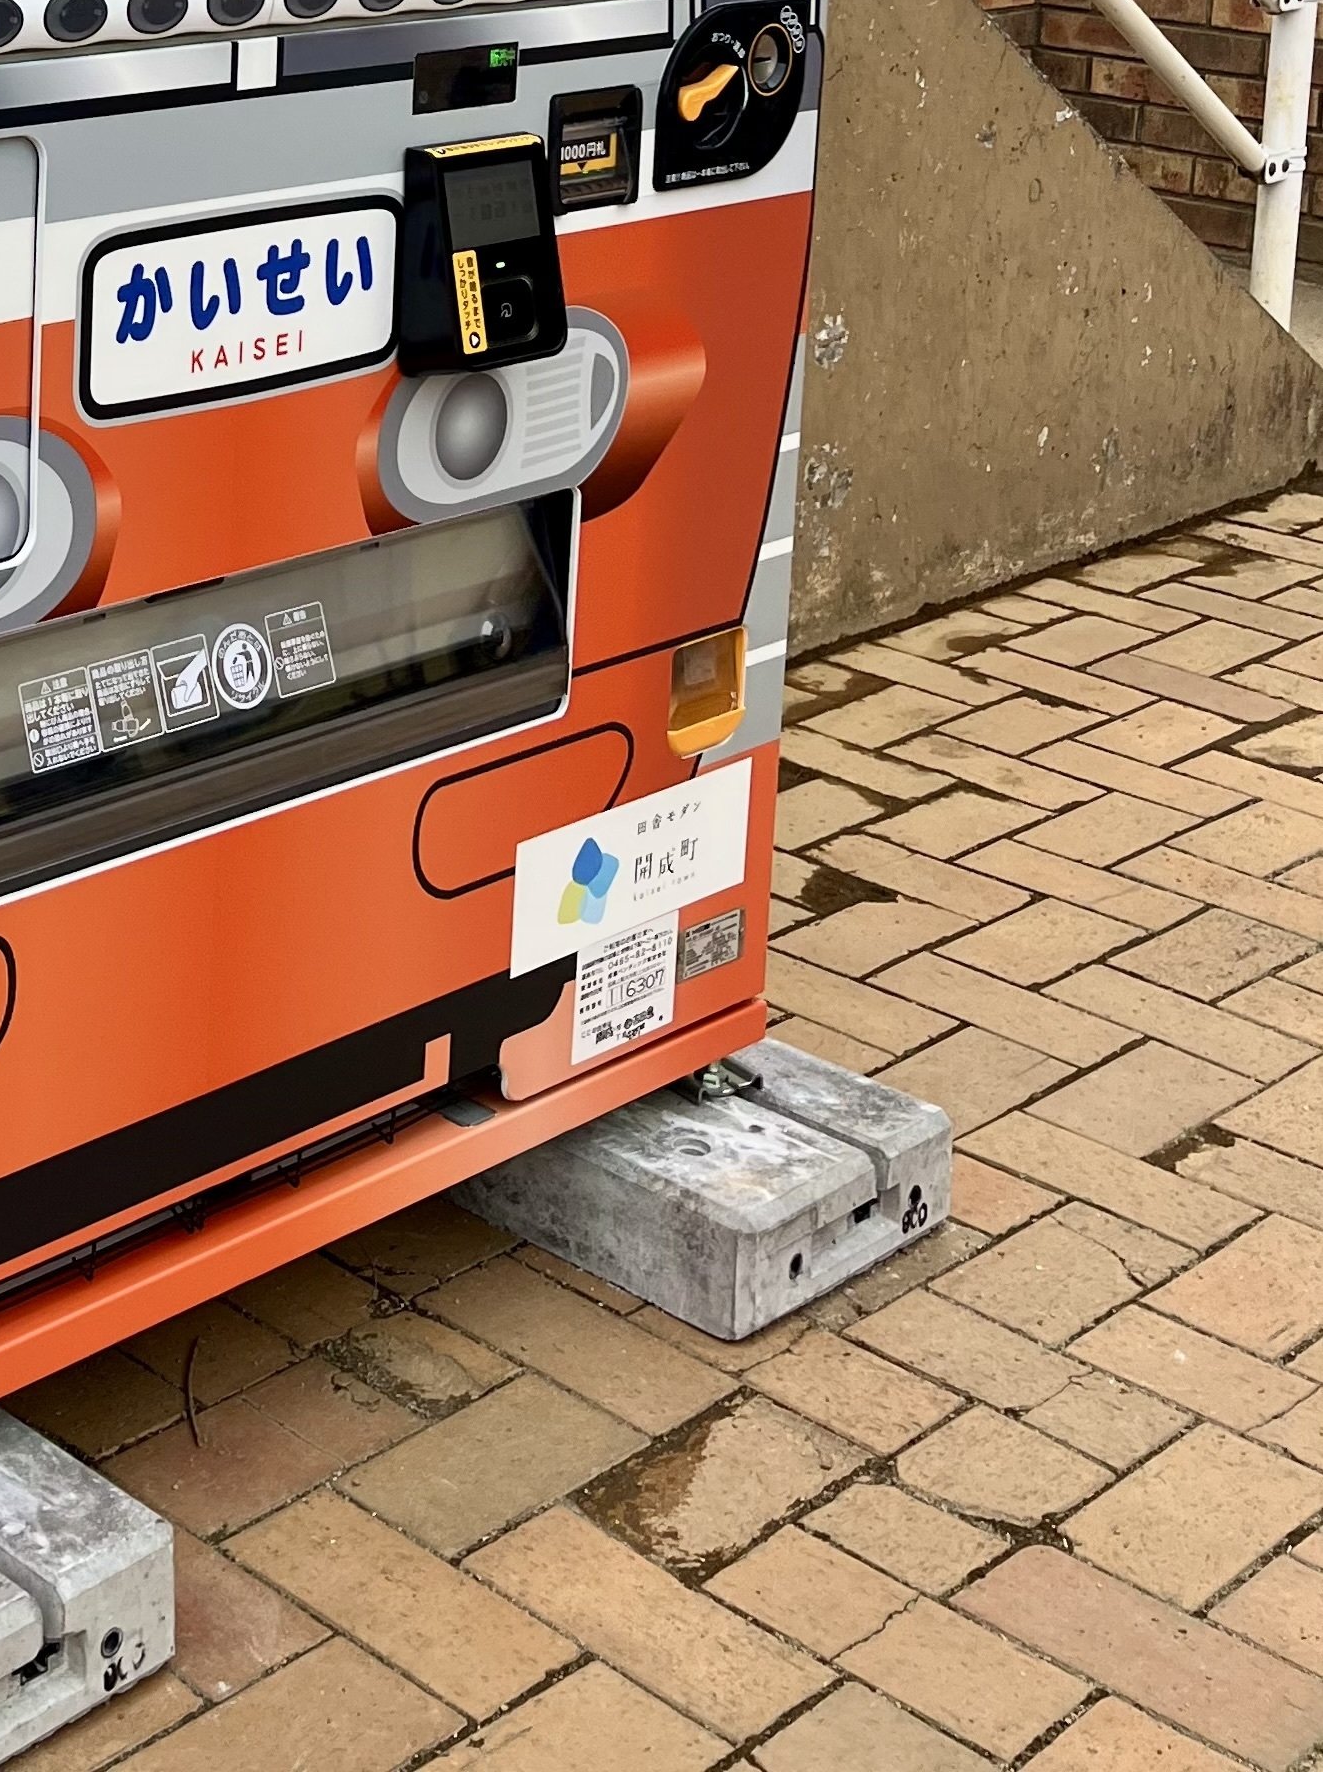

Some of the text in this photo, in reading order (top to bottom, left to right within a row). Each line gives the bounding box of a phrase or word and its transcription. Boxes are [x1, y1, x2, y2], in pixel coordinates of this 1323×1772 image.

[560, 140, 607, 162] 1000円札
[116, 235, 373, 345] かいせい
[190, 329, 304, 374] KAISEI
[636, 800, 702, 836] 田舎モダン
[633, 836, 699, 885] 開成町
